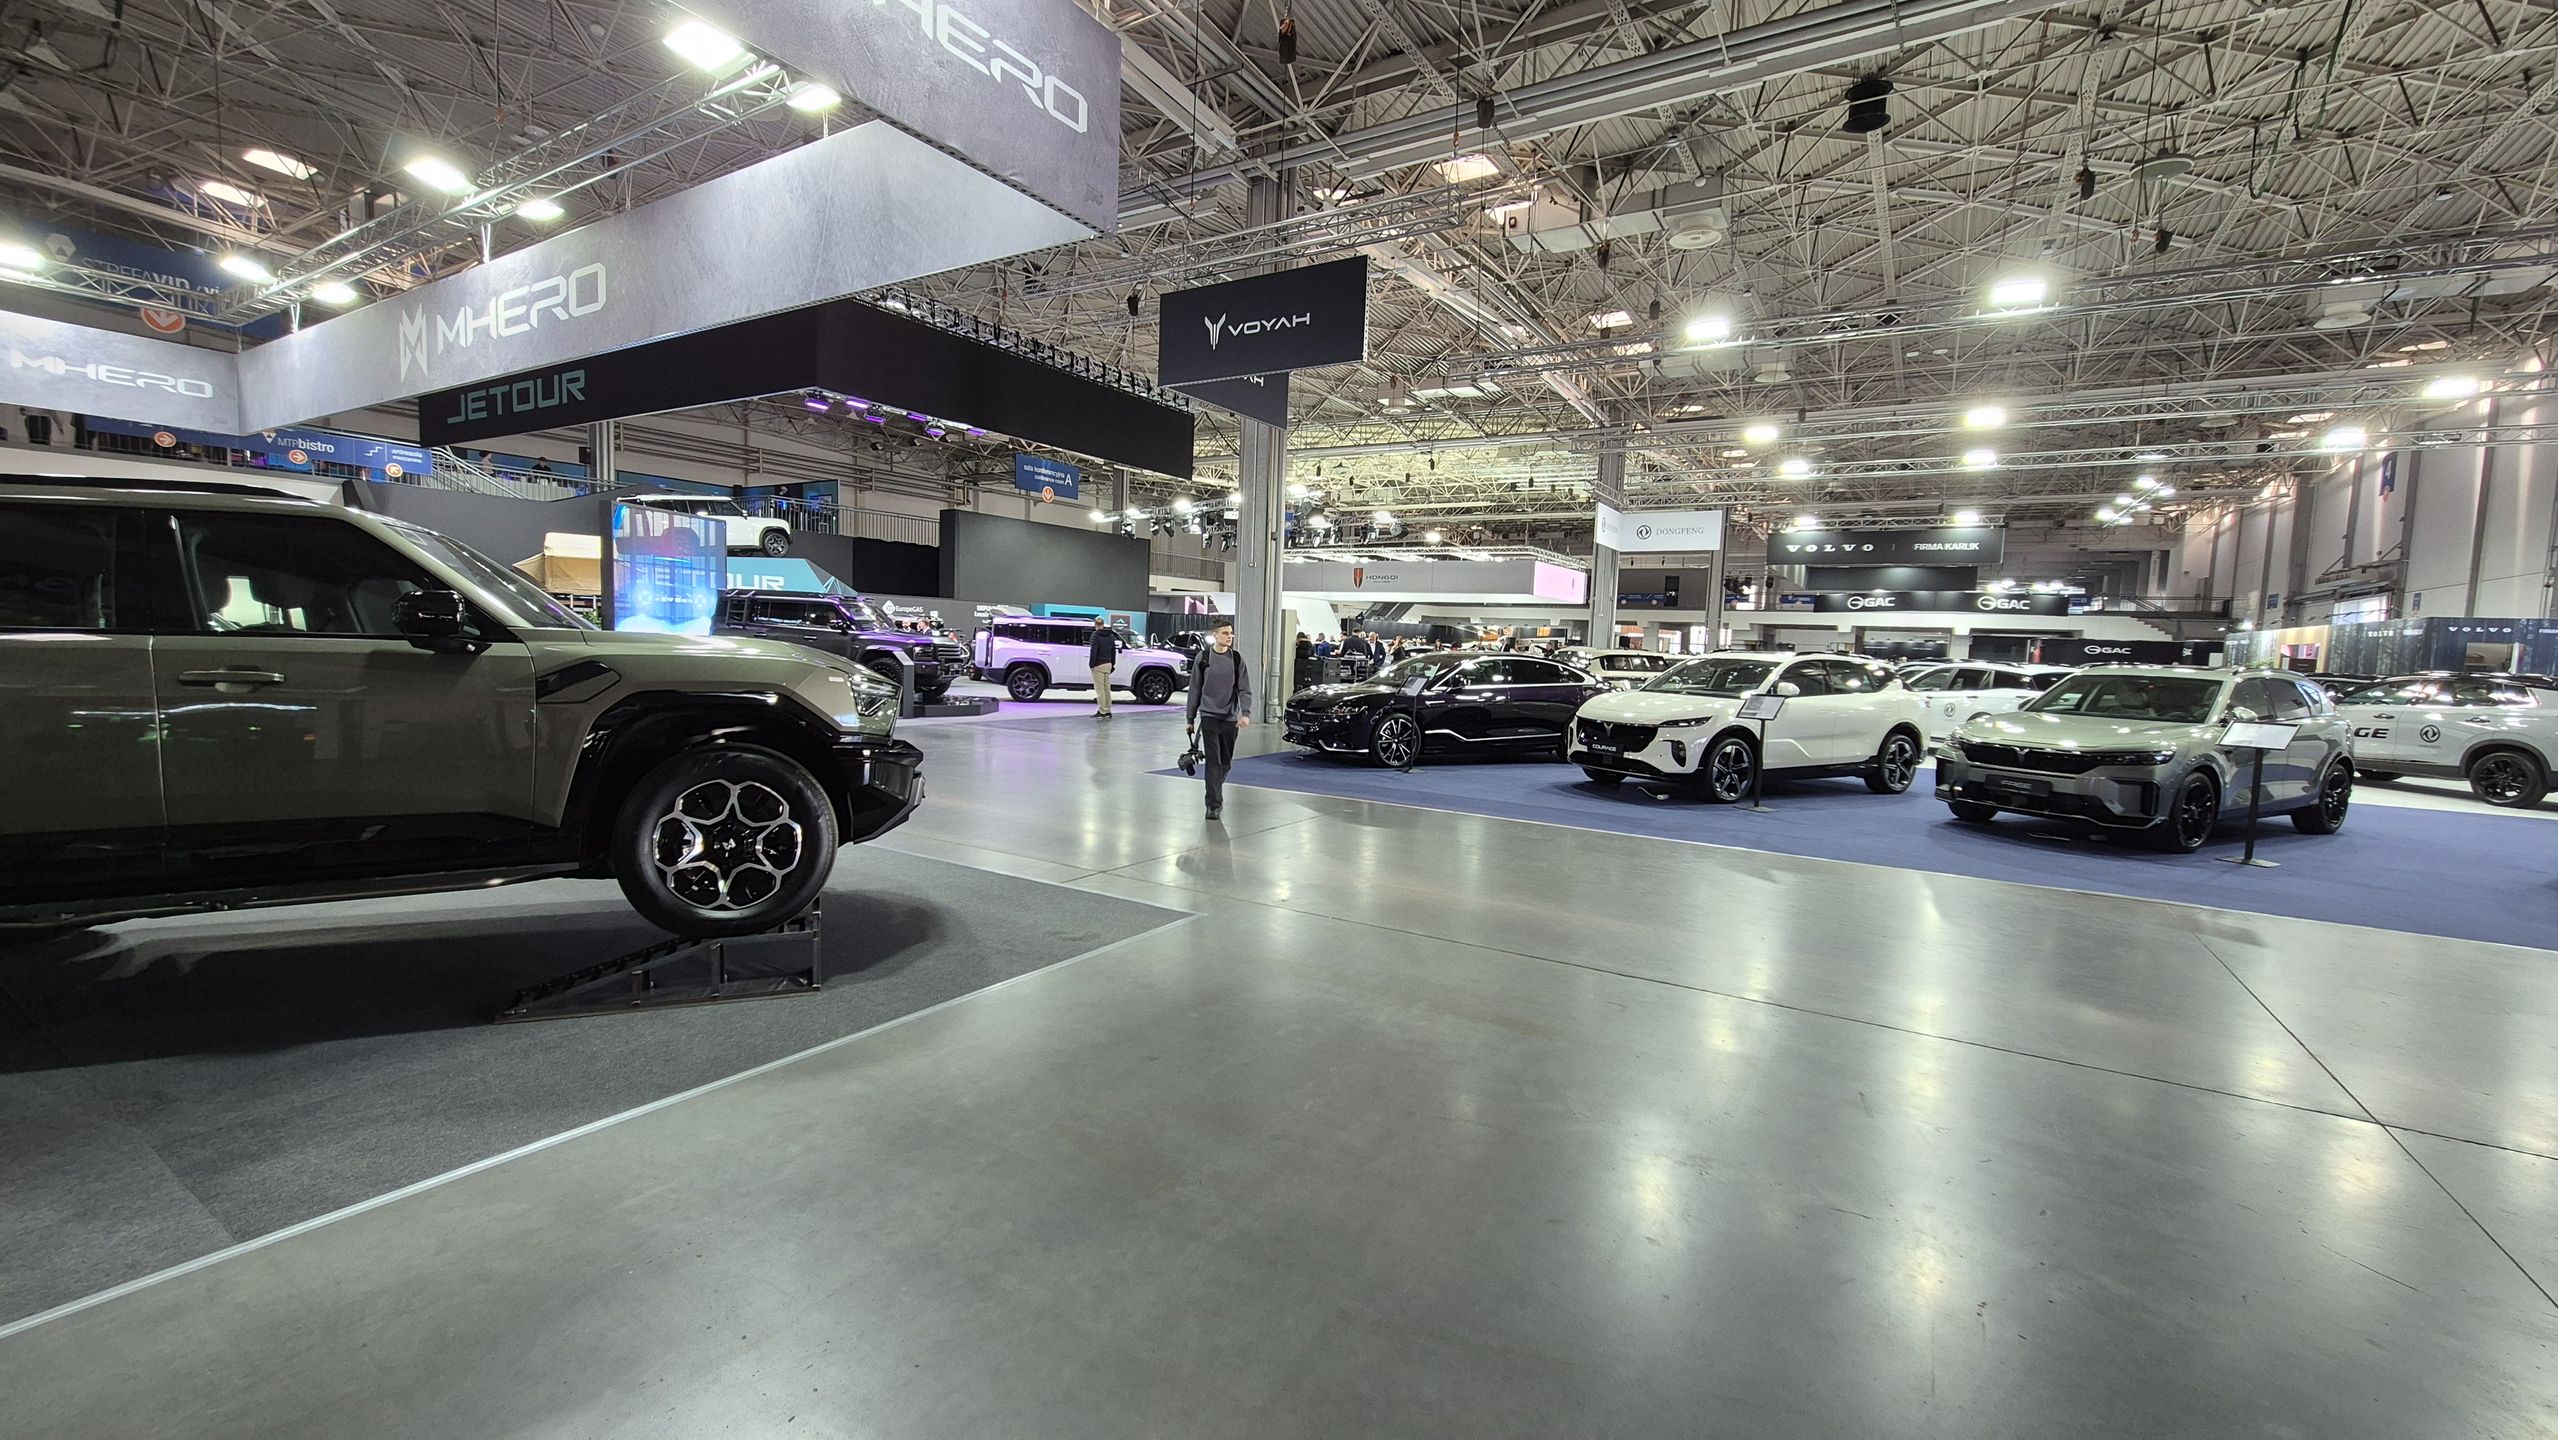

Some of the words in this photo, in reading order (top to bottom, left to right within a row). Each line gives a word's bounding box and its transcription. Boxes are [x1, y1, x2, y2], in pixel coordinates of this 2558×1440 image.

[437, 263, 607, 355] MHERO
[1228, 312, 1310, 336] VOYAH
[10, 350, 213, 399] MHERO
[447, 369, 586, 424] JETOUR
[1064, 473, 1073, 487] A
[1656, 527, 1704, 536] DONGFENG
[1786, 544, 1874, 552] VOLVO
[1944, 542, 1980, 550] KARLIK
[1863, 597, 1896, 607] GAC
[1996, 599, 2031, 609] GAC
[2353, 727, 2390, 739] GE
[1592, 744, 1617, 752] COURAGE
